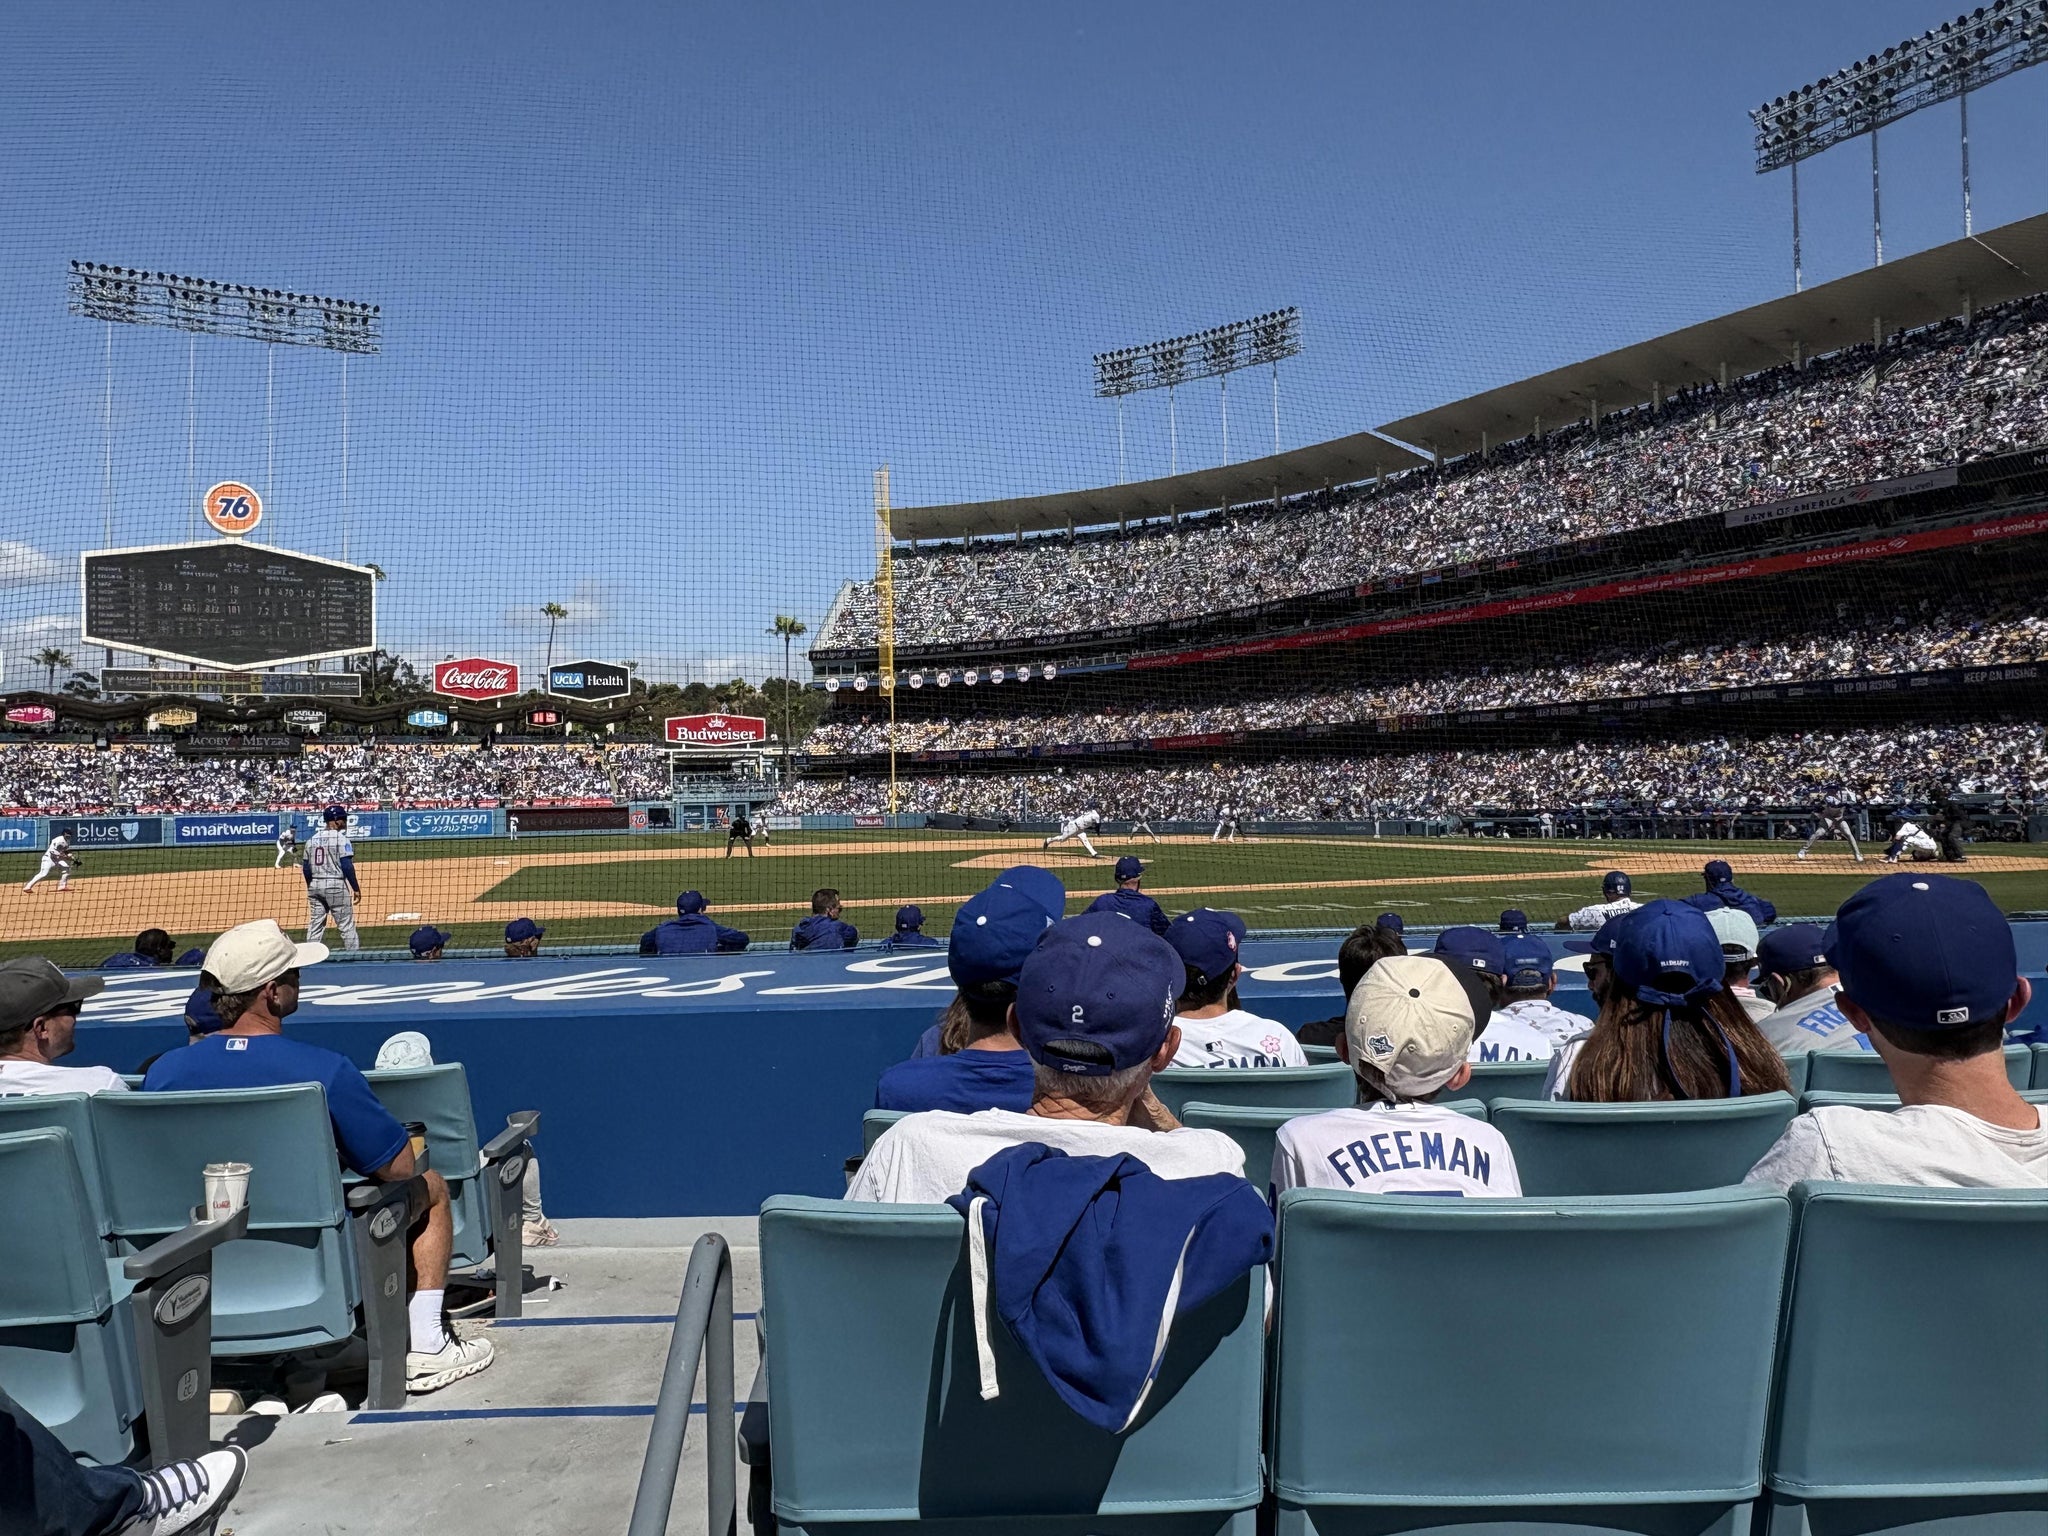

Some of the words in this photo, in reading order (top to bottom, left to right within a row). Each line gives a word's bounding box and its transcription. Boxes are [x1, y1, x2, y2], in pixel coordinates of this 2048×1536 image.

[219, 497, 250, 517] 76
[1744, 512, 1772, 522] BANK
[1793, 497, 1845, 513] AMERICA
[1909, 481, 1933, 492] Level
[555, 676, 581, 685] UCLA
[587, 675, 624, 686] Health
[1964, 672, 1987, 683] KEEP
[1989, 671, 2002, 680] ON
[2005, 668, 2037, 680] RISING
[1834, 683, 1854, 694] KEEP
[1869, 679, 1897, 691] RISING
[187, 735, 231, 746] JACOBY
[242, 735, 290, 746] MEYERS
[676, 727, 757, 740] Budweiser
[422, 814, 487, 826] SYNCRON
[77, 823, 119, 838] blue
[181, 822, 275, 837] smartwater
[1072, 1005, 1084, 1023] 2
[1327, 1131, 1490, 1188] FREEMAN
